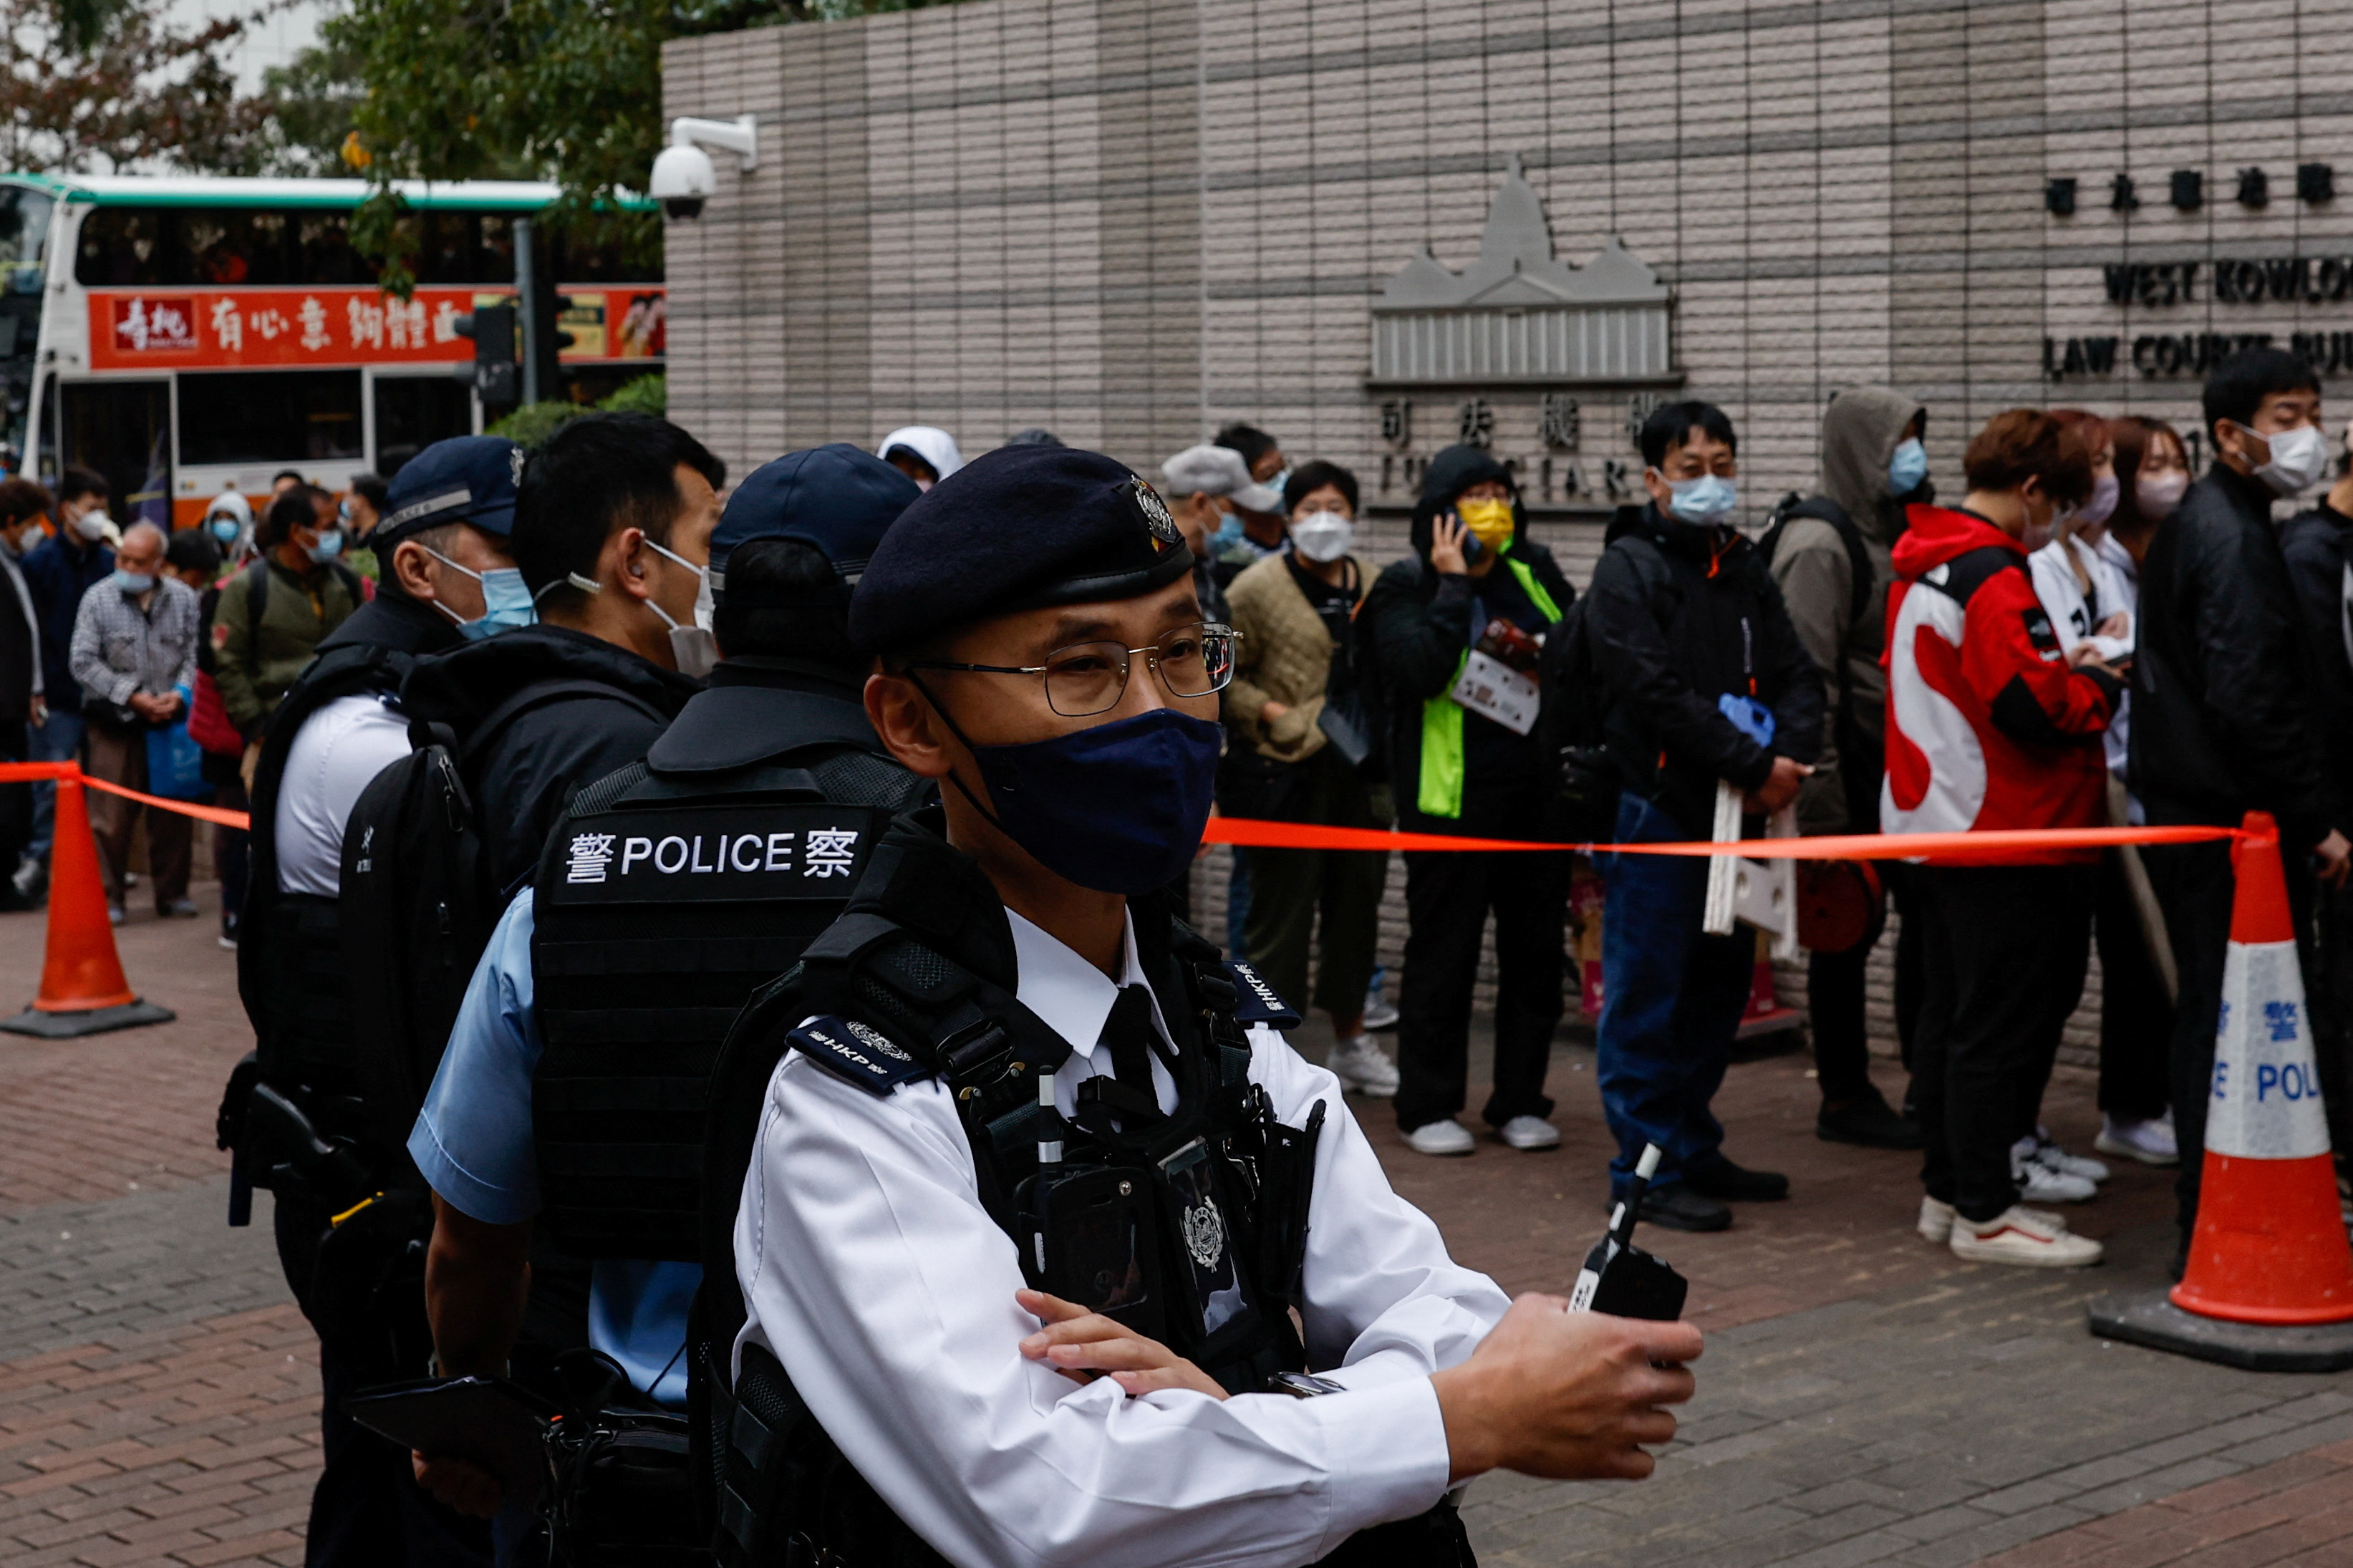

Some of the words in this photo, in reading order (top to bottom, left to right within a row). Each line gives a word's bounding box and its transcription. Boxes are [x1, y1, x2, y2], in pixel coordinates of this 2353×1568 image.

[2105, 263, 2198, 306] WEST
[2044, 337, 2118, 382] LAW
[566, 833, 617, 884] 警
[621, 833, 796, 875] POLICE
[803, 826, 859, 879] 察
[823, 1038, 870, 1065] HKP
[2258, 1062, 2320, 1103] POL
